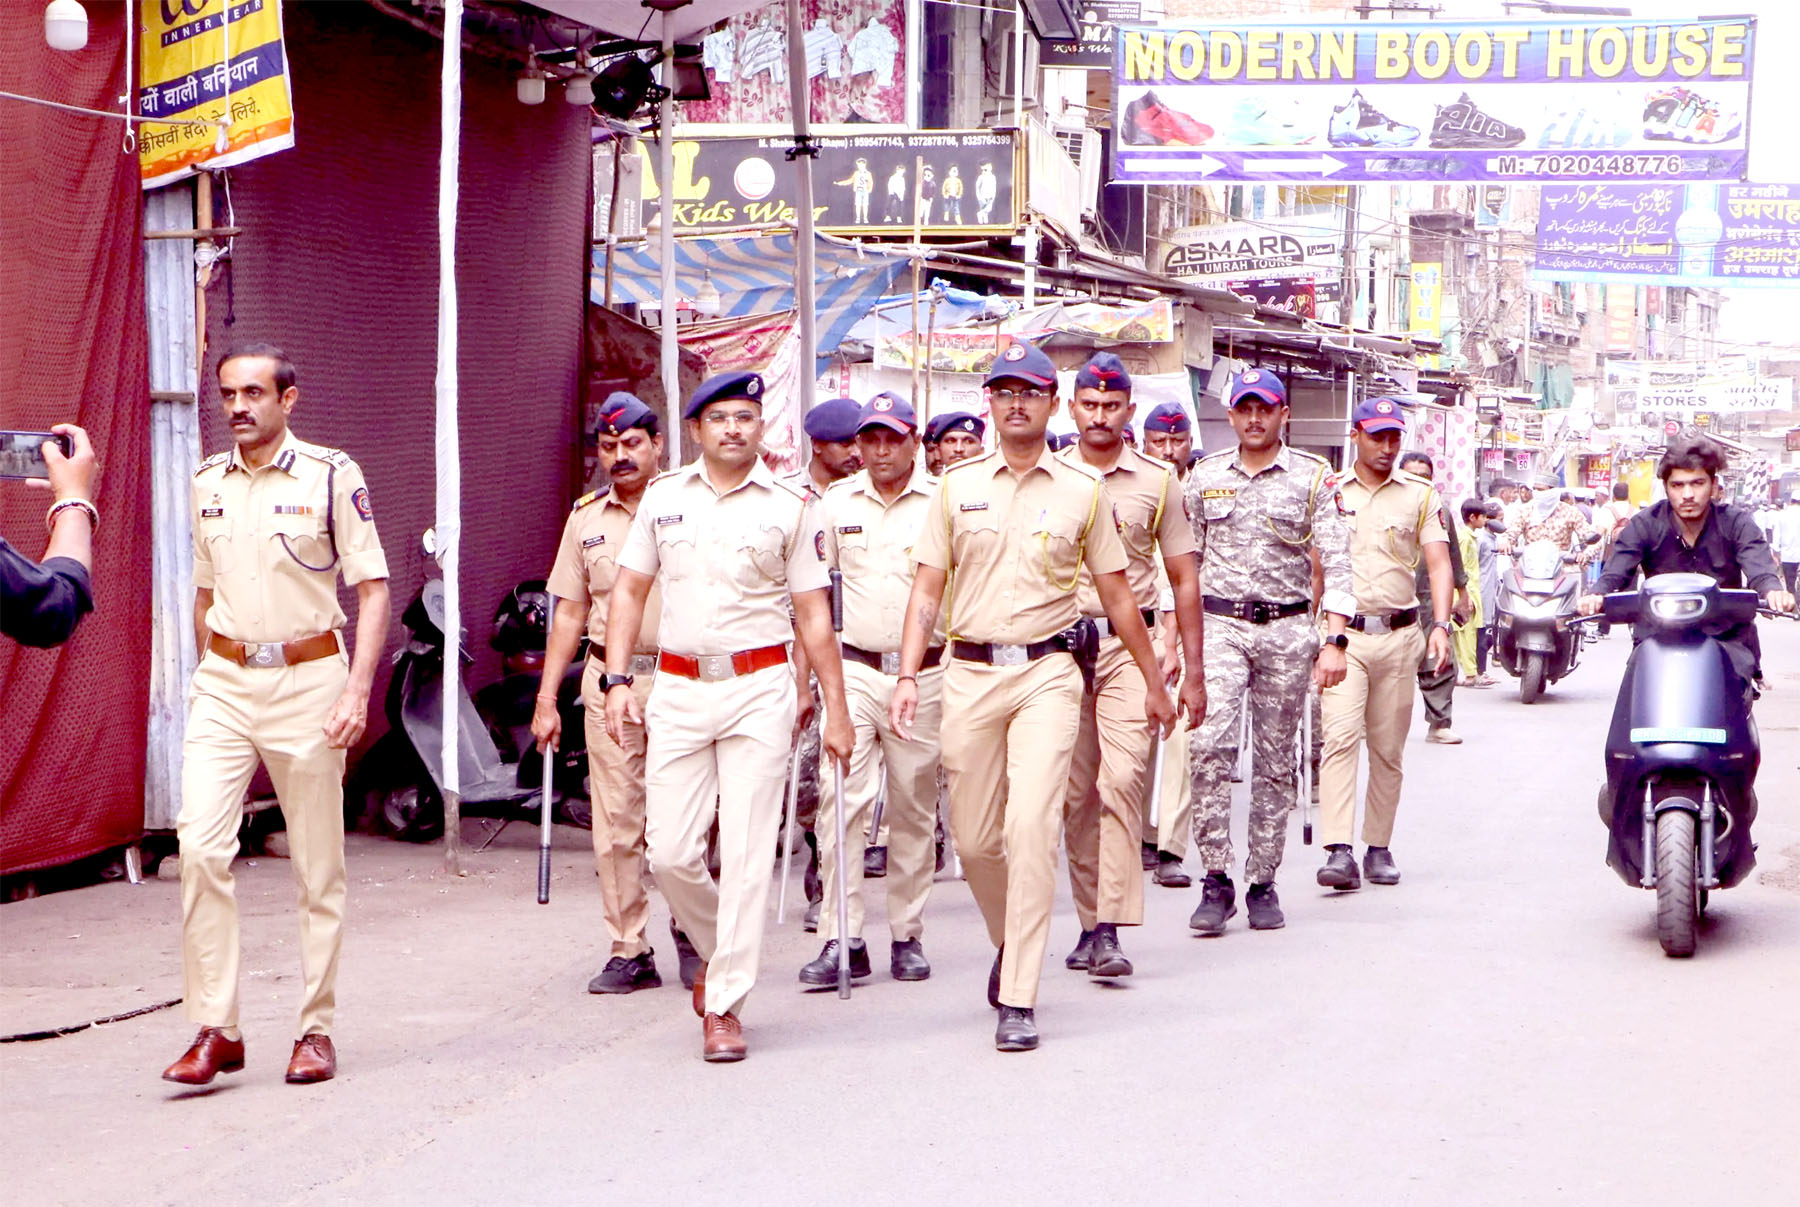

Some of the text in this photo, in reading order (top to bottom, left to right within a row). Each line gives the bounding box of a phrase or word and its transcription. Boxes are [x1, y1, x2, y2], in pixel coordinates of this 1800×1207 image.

[164, 19, 212, 44] INNER
[1053, 43, 1085, 54] Kis
[1123, 24, 1747, 81] MODERN BOOT HOUSE
[163, 74, 198, 107] वाली
[1497, 155, 1682, 176] M: 7020448776
[671, 199, 829, 226] Kids Wer
[1177, 255, 1294, 277] HAJ UMRAH TOURS
[1642, 395, 1708, 407] STORES
[1519, 460, 1528, 470] 50
